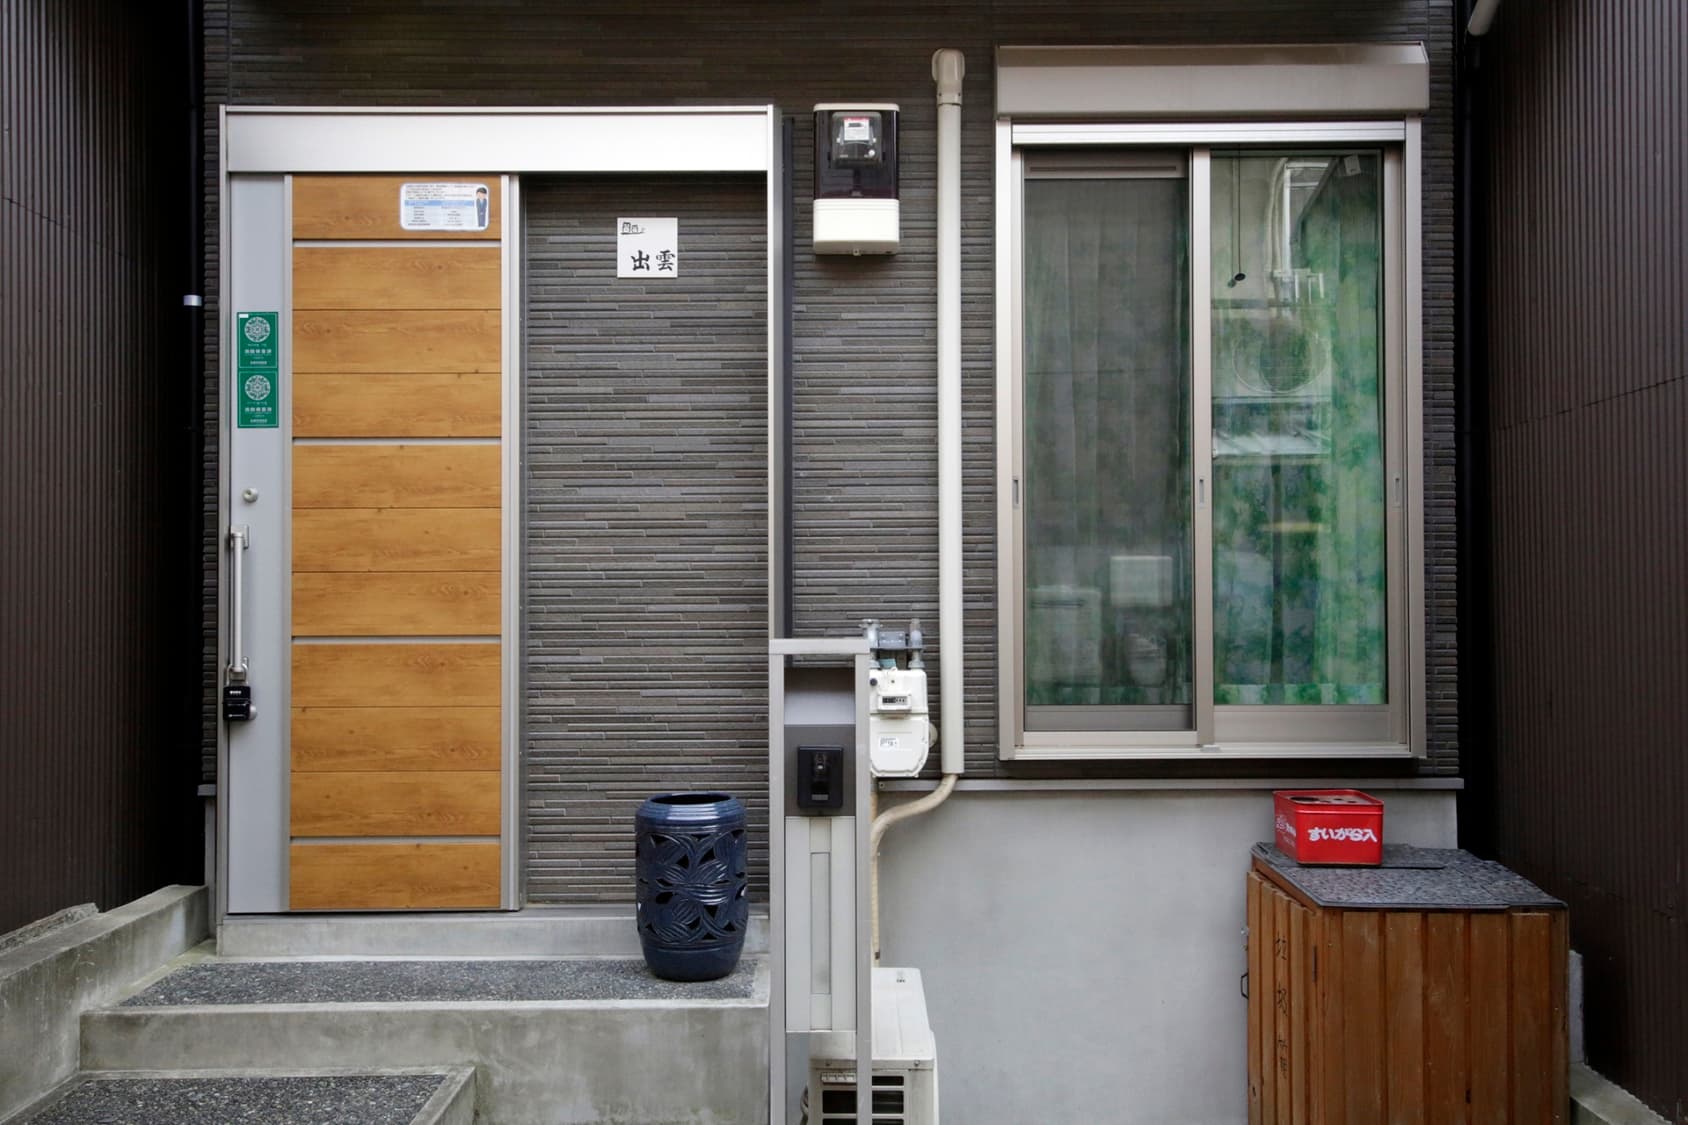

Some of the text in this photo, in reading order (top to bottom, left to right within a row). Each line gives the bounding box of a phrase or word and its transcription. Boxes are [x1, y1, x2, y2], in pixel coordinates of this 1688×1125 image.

[630, 249, 676, 271] 出雲
[1307, 827, 1378, 843] すいがら入
